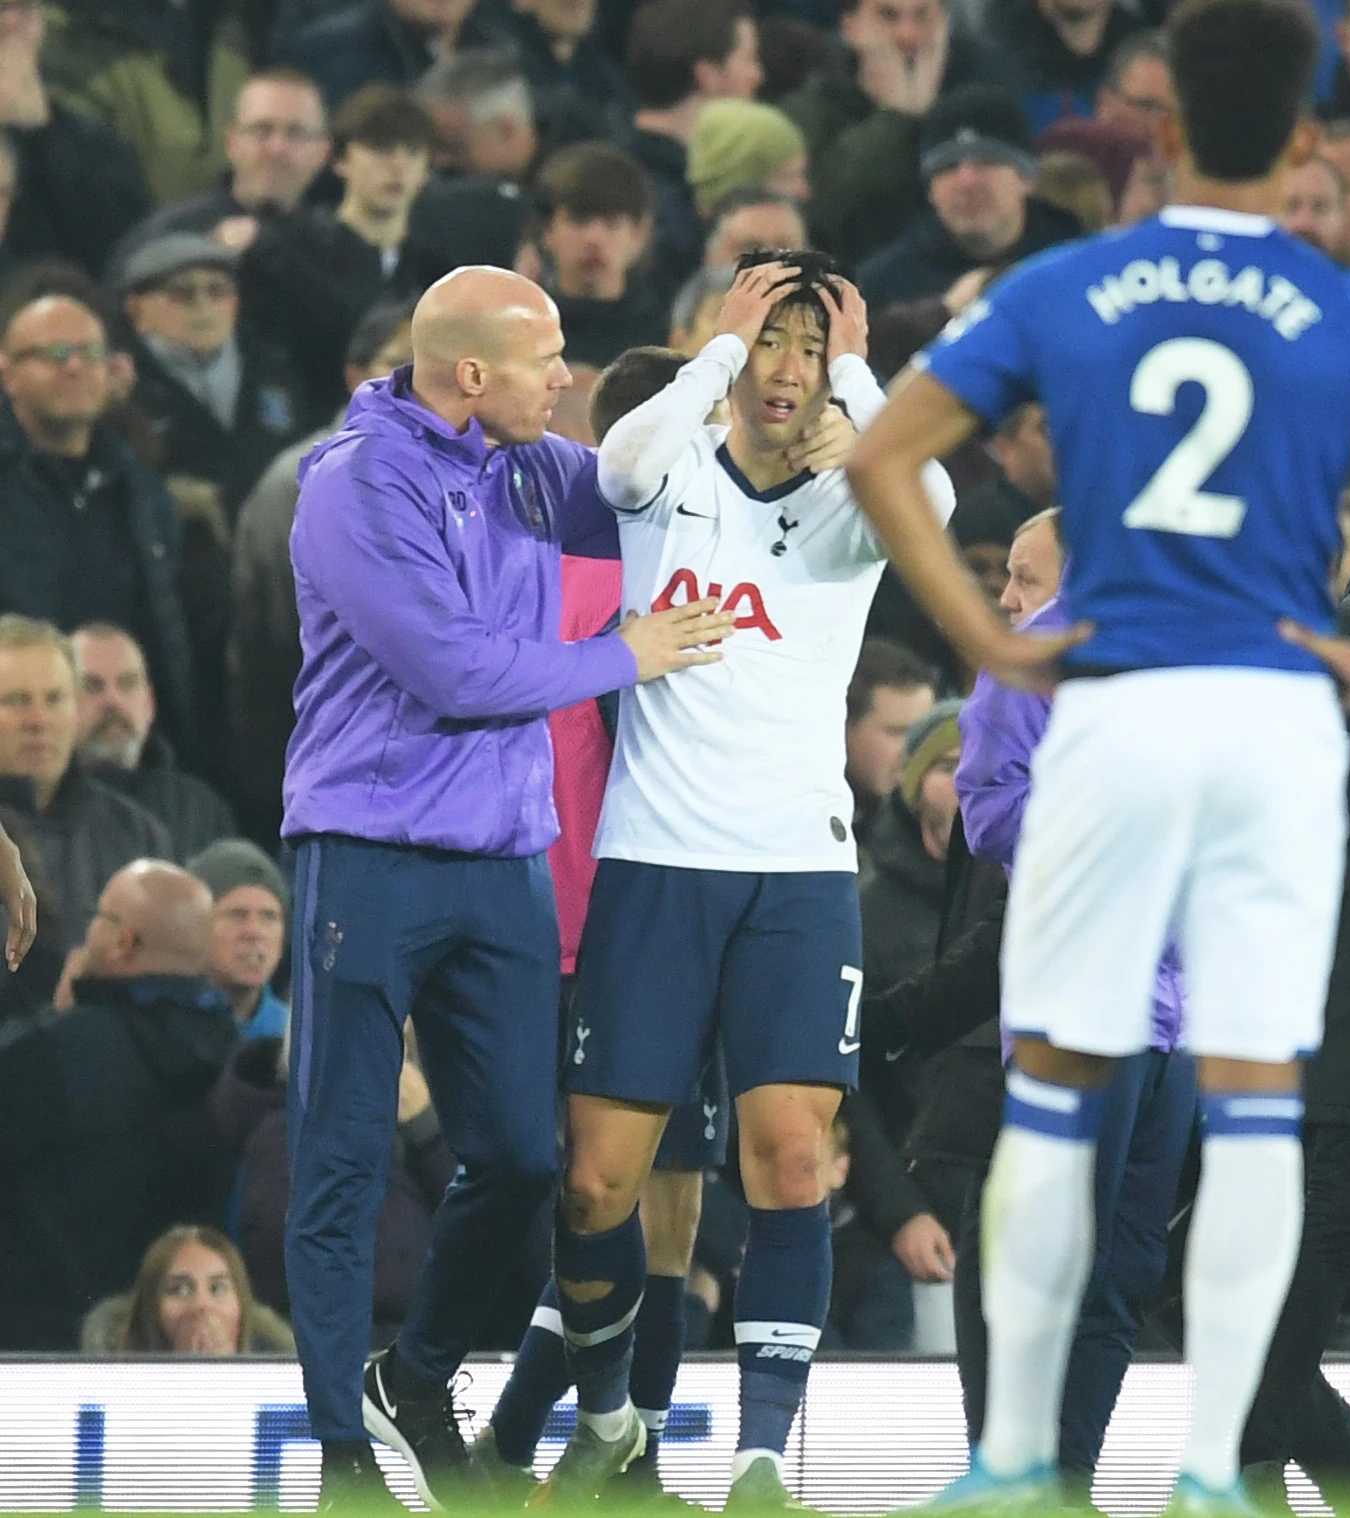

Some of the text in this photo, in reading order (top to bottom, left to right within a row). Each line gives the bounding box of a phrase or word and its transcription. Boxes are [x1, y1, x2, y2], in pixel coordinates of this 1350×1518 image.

[1086, 255, 1323, 341] HOLGATE
[1122, 336, 1255, 539] 2
[840, 964, 864, 1038] 7
